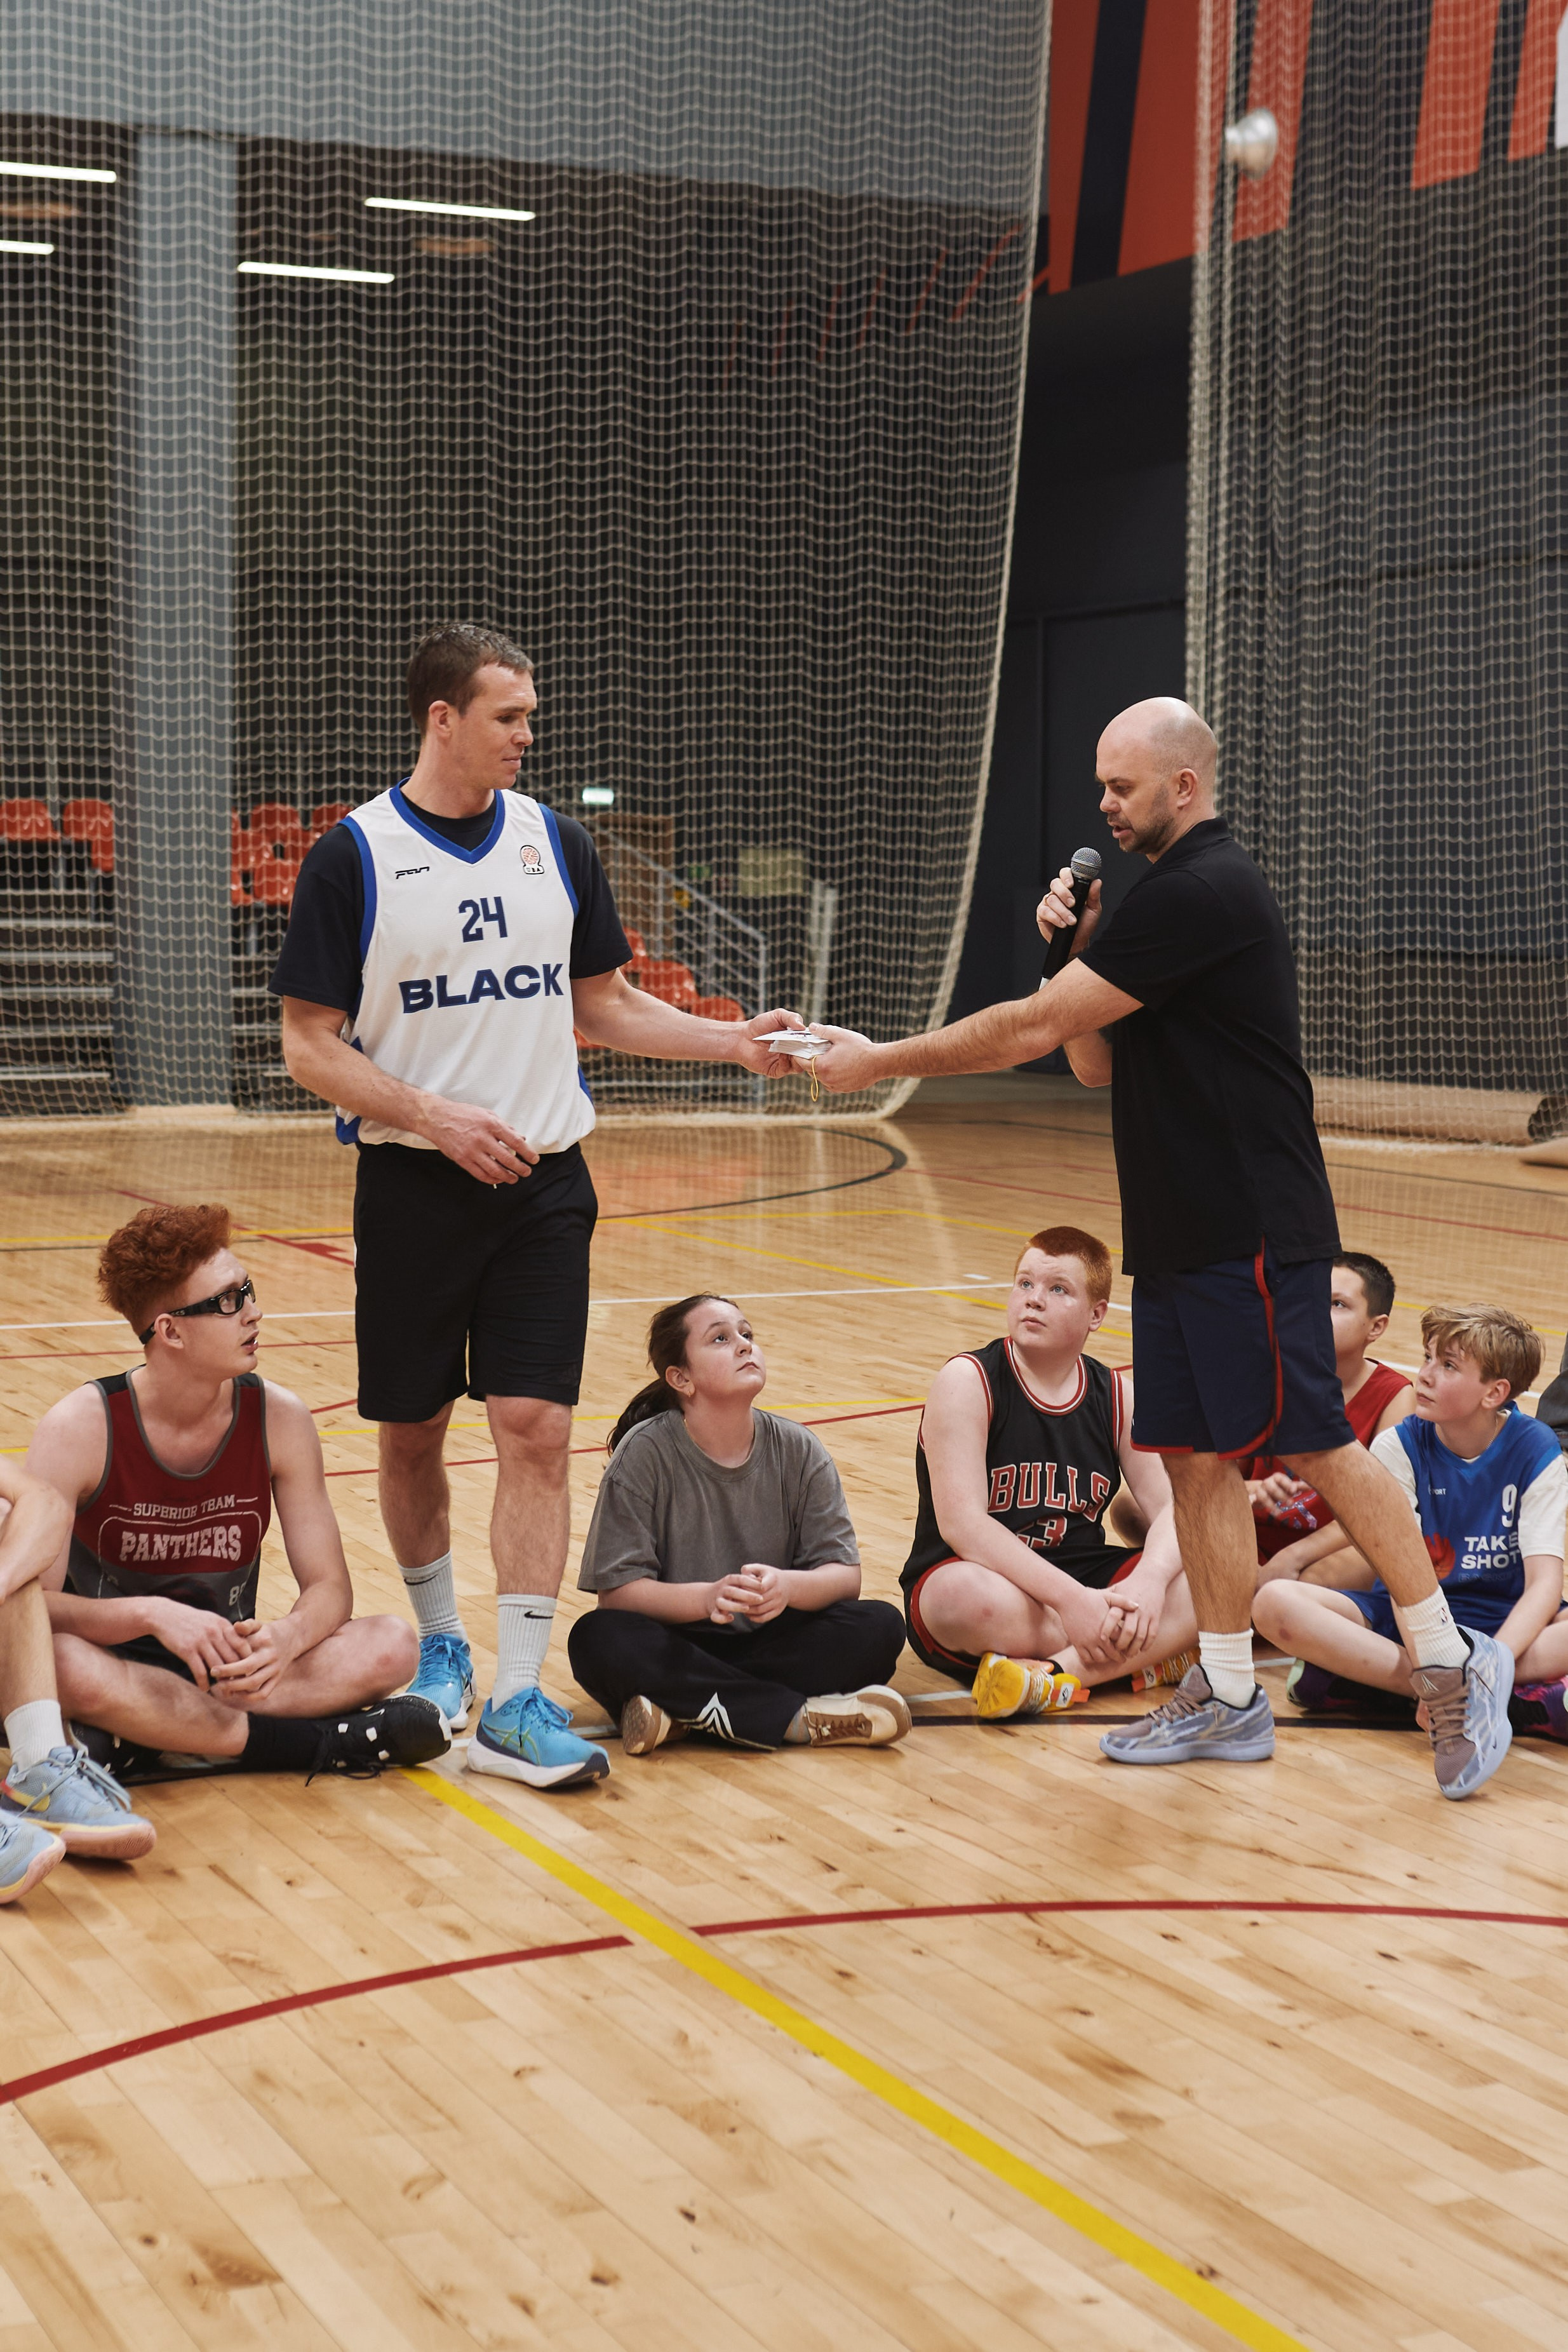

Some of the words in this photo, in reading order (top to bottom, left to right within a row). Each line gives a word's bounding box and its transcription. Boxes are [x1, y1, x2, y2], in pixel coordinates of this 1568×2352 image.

[458, 896, 508, 943] 24
[399, 964, 564, 1014] BLACK
[133, 1503, 198, 1519] SUPERIOR
[201, 1495, 236, 1513] TEAM
[987, 1462, 1110, 1522] BULLS
[1501, 1483, 1518, 1528] 9
[119, 1525, 242, 1562] PANTHERS
[1461, 1549, 1520, 1569] SHOT
[1464, 1531, 1519, 1552] TAKE
